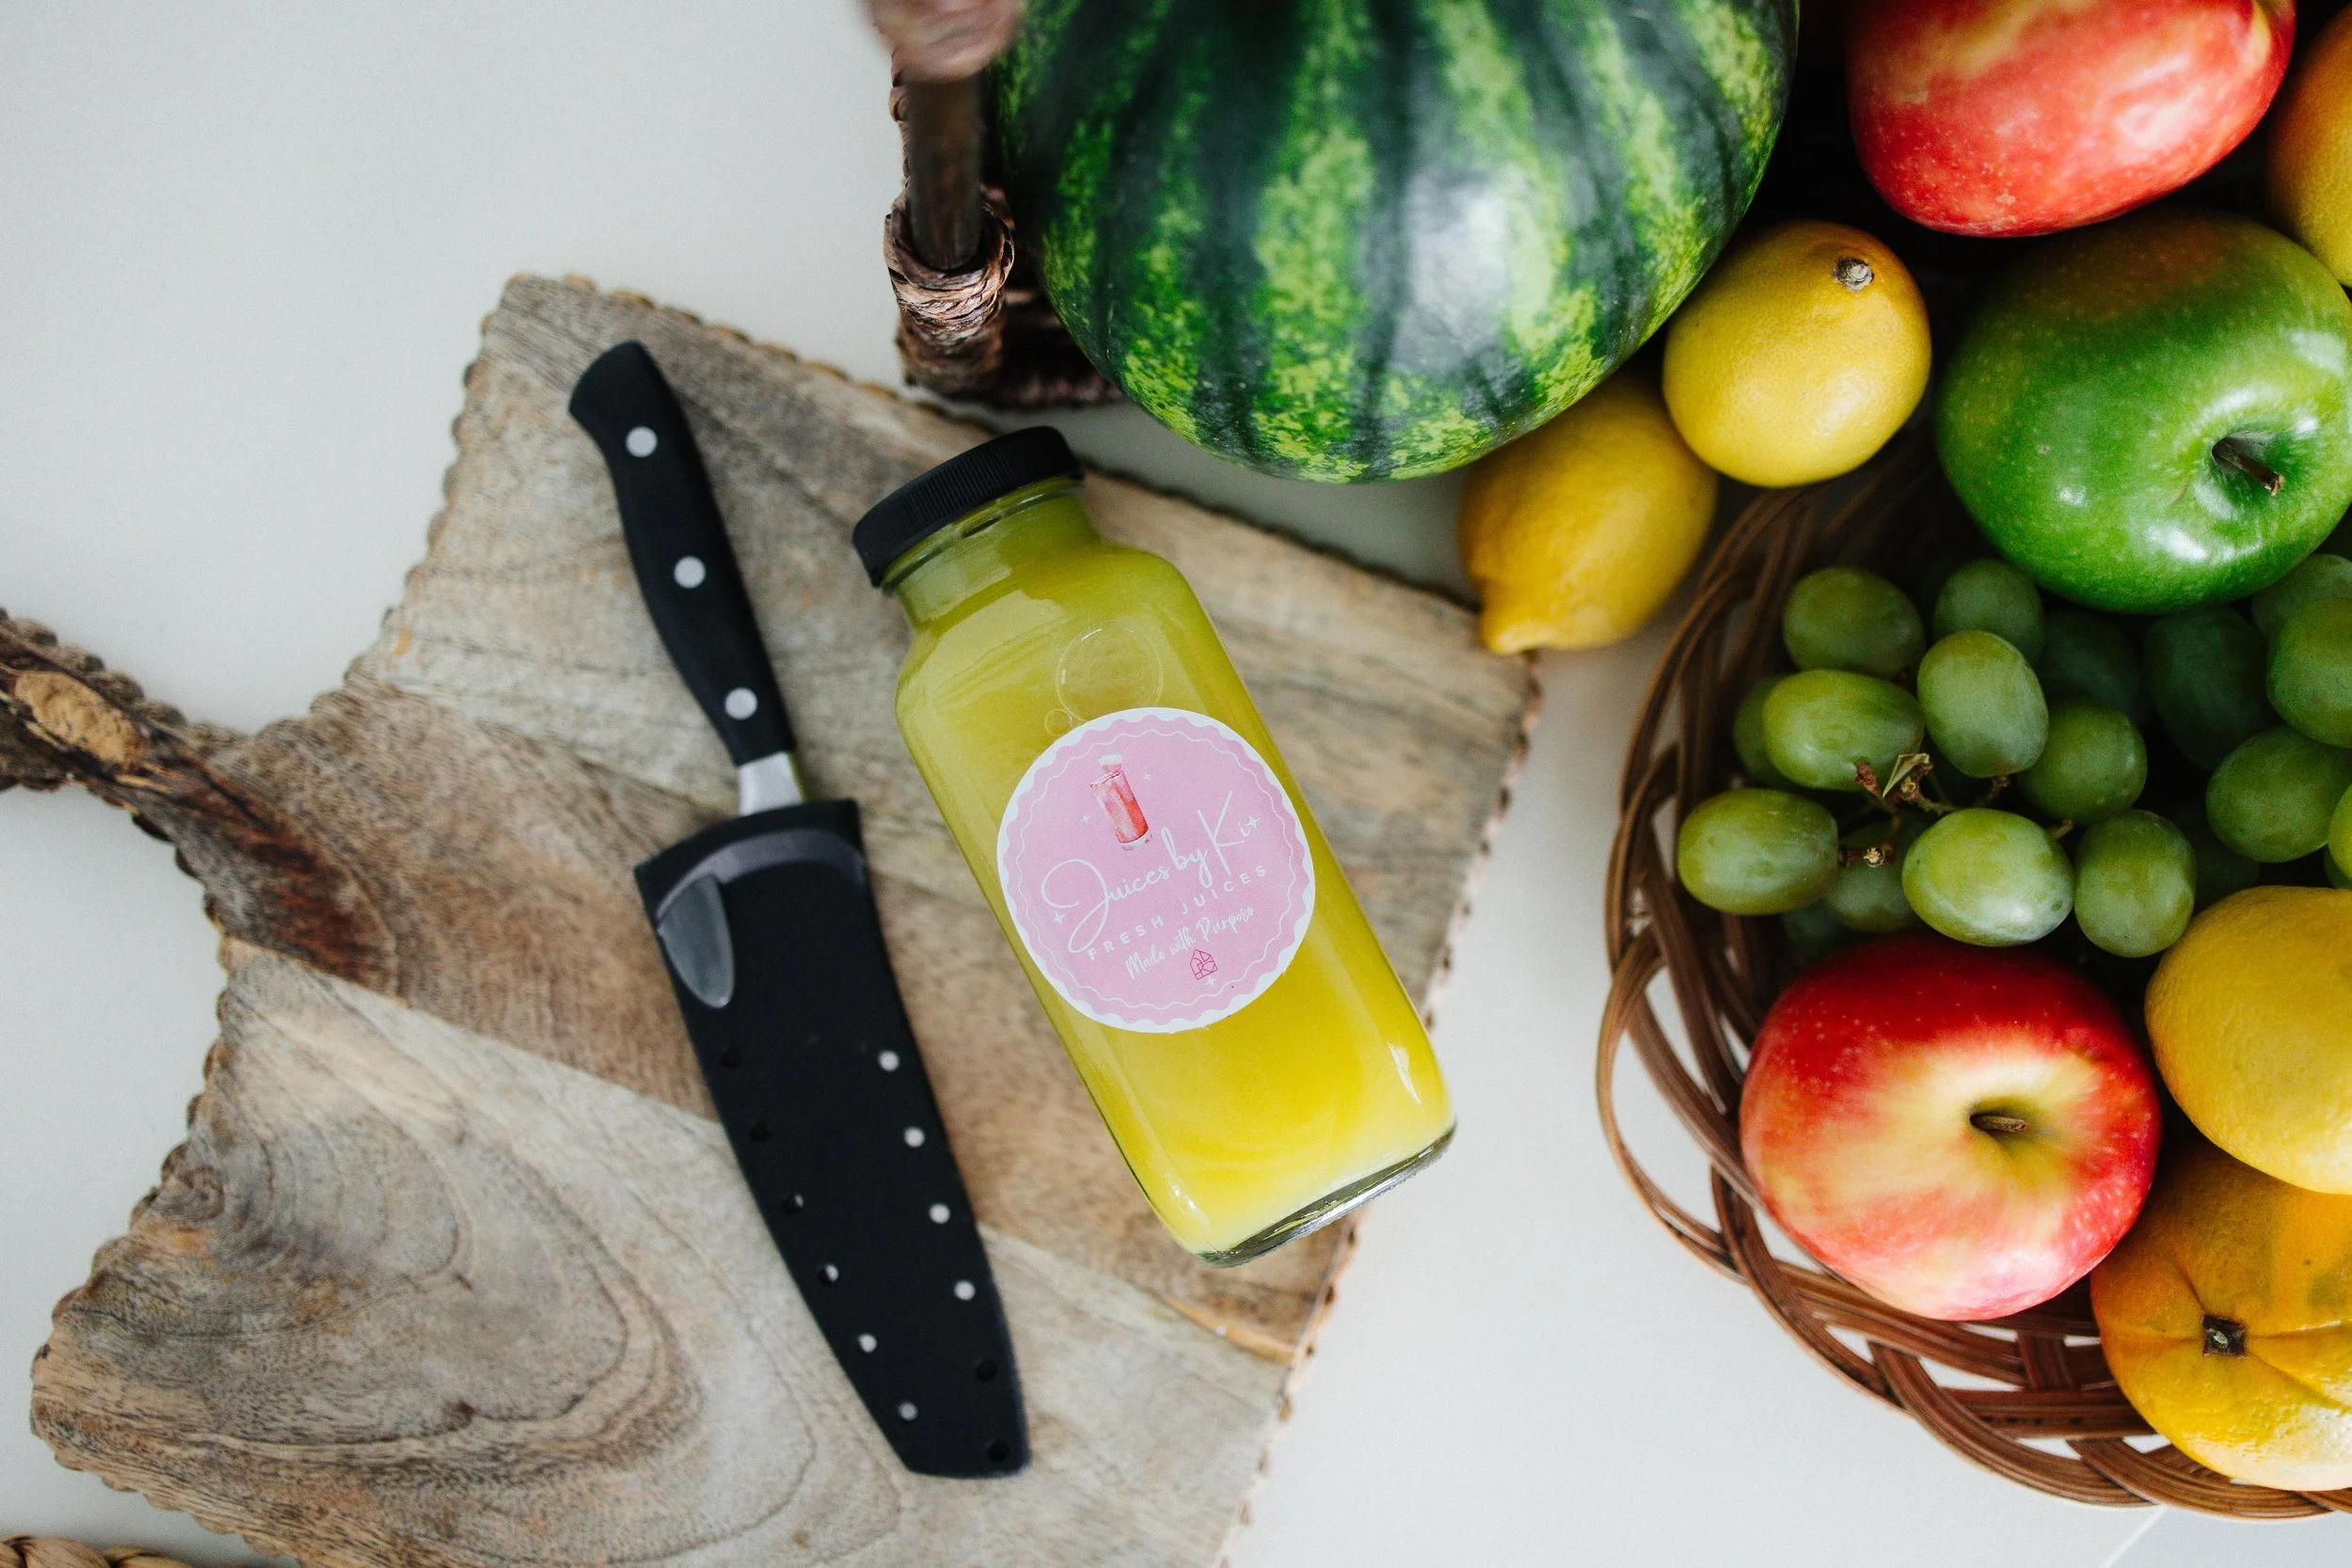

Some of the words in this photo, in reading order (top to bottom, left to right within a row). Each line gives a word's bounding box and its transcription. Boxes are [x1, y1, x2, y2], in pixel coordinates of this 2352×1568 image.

[1041, 858, 1171, 954] Juices
[1160, 827, 1213, 889] by
[1088, 915, 1165, 960] FRESH
[1181, 864, 1265, 915] JUICES
[1124, 943, 1166, 980] Made
[1168, 926, 1197, 957] with
[1195, 906, 1254, 942] Purpose
